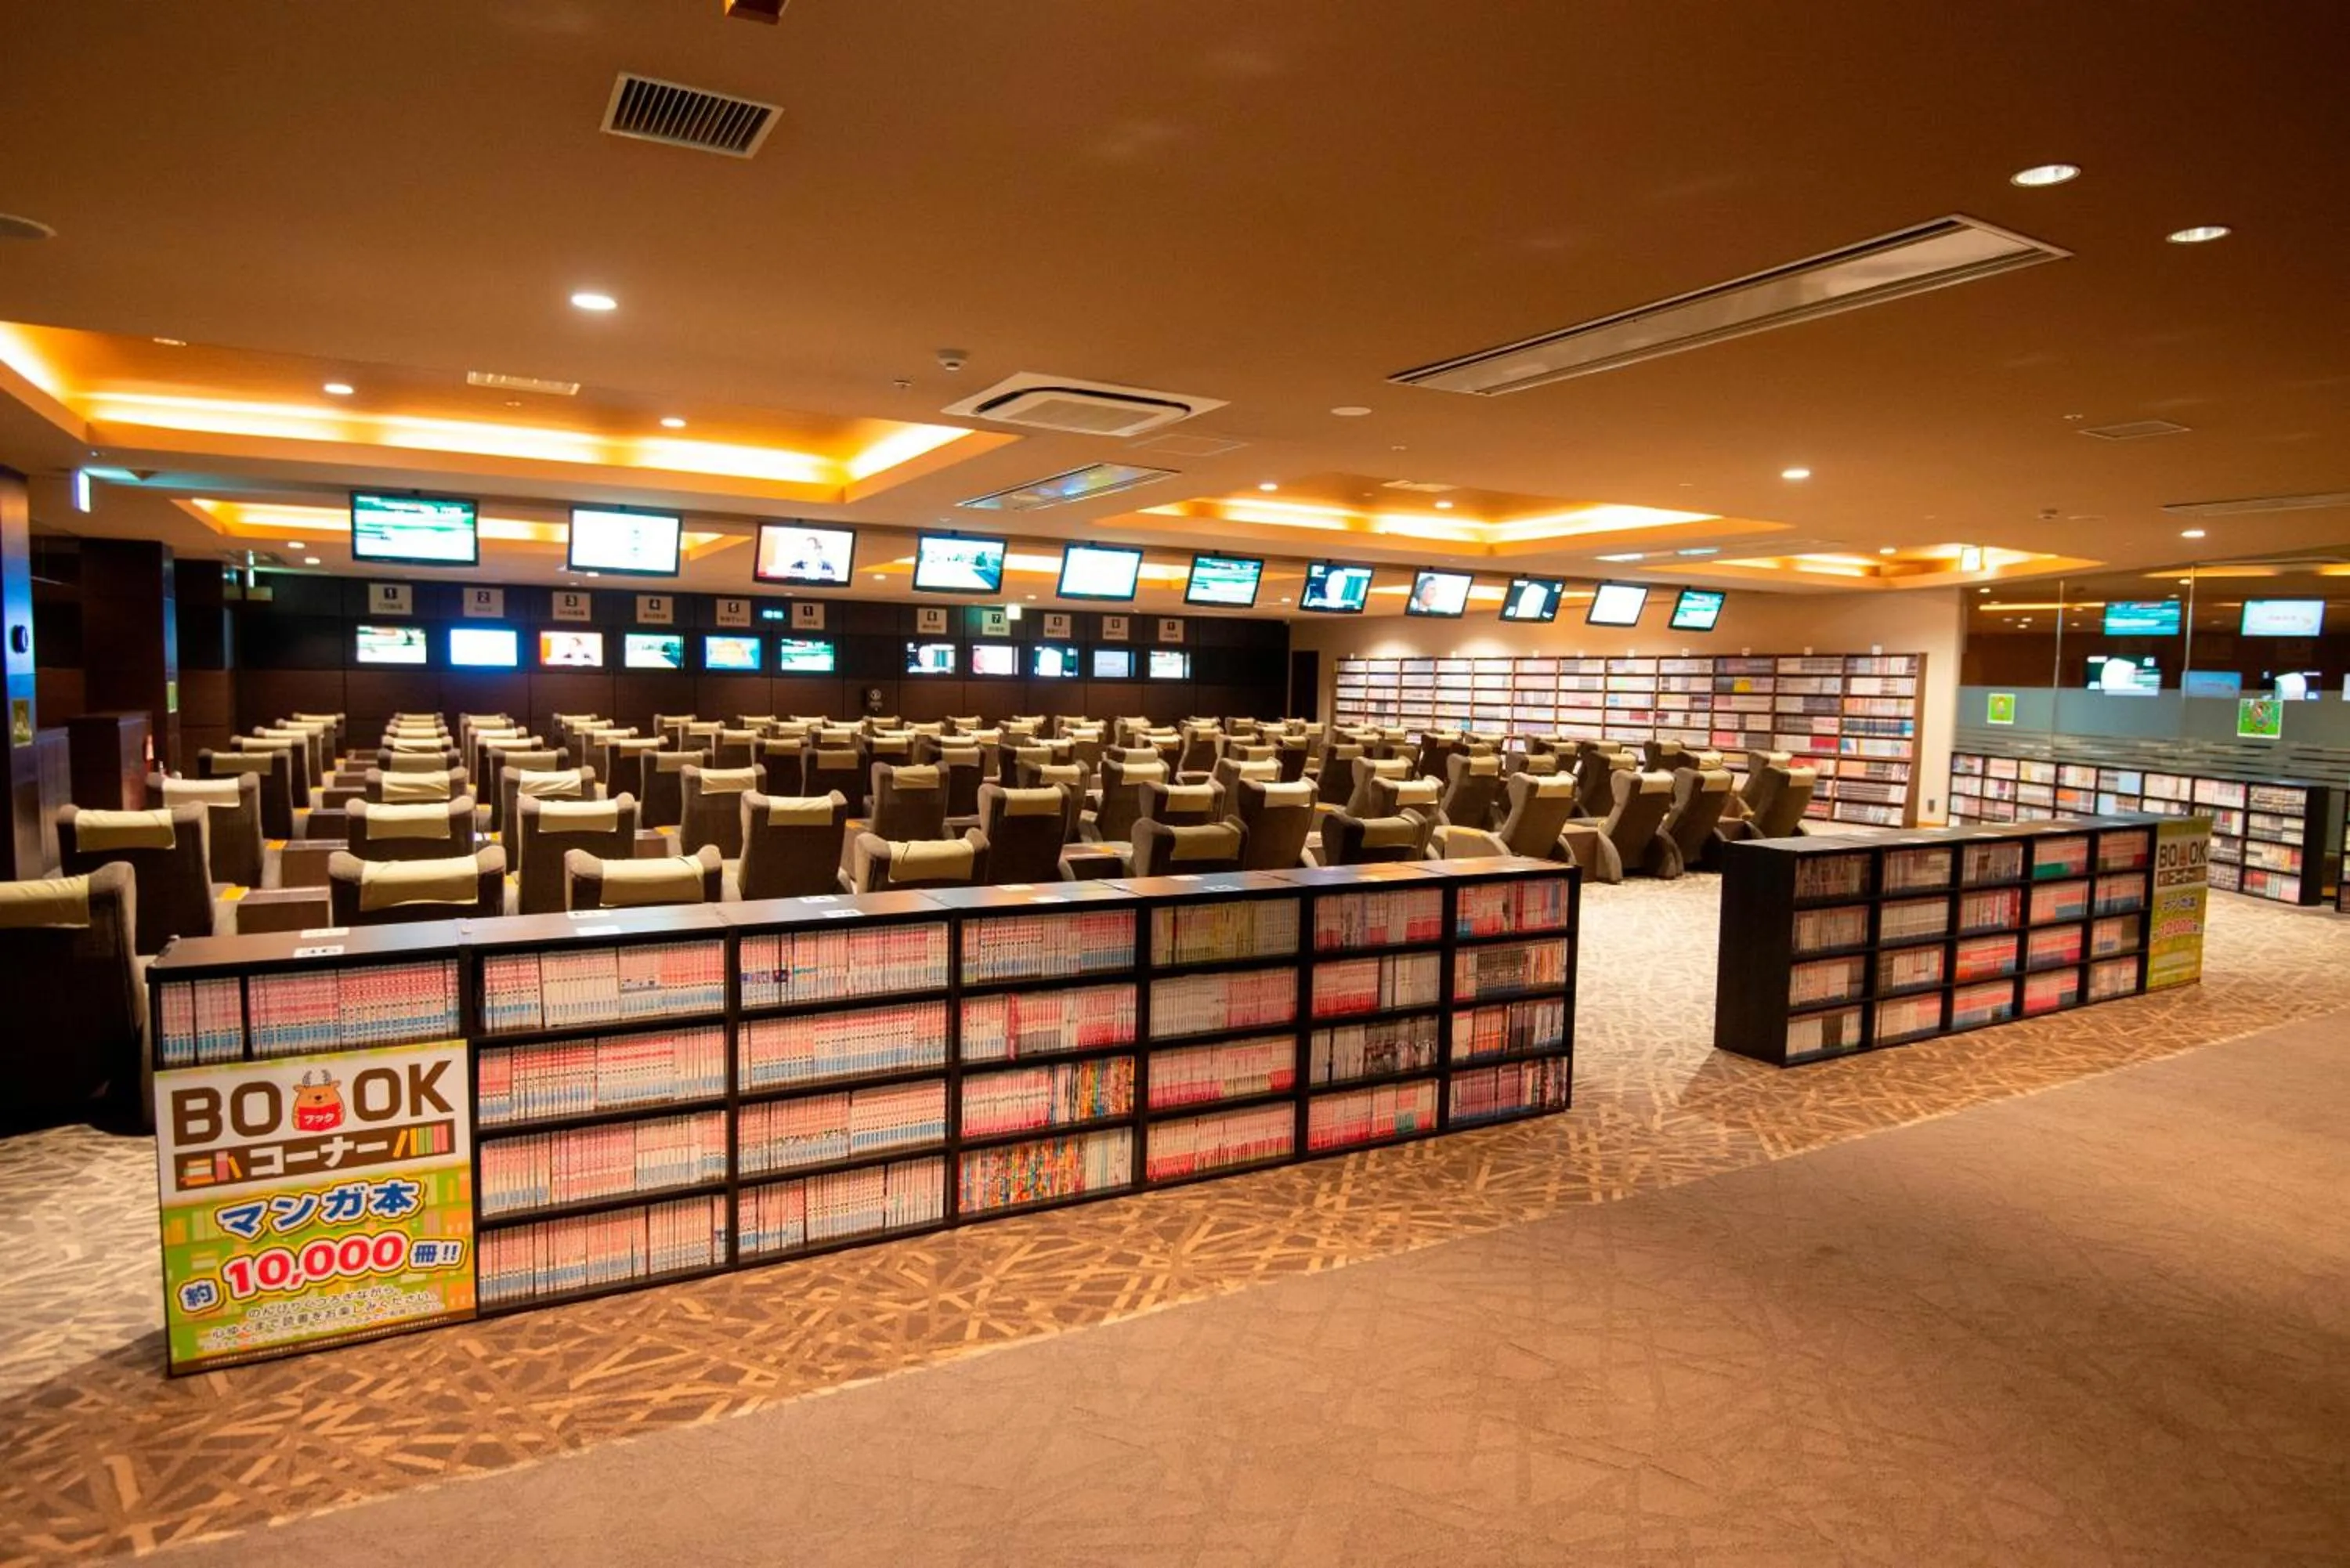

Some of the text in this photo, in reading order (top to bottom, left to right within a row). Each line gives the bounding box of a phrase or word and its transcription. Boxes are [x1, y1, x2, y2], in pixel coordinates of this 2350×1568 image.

[249, 1136, 389, 1174] コーナー
[220, 1181, 417, 1235] マンガ本
